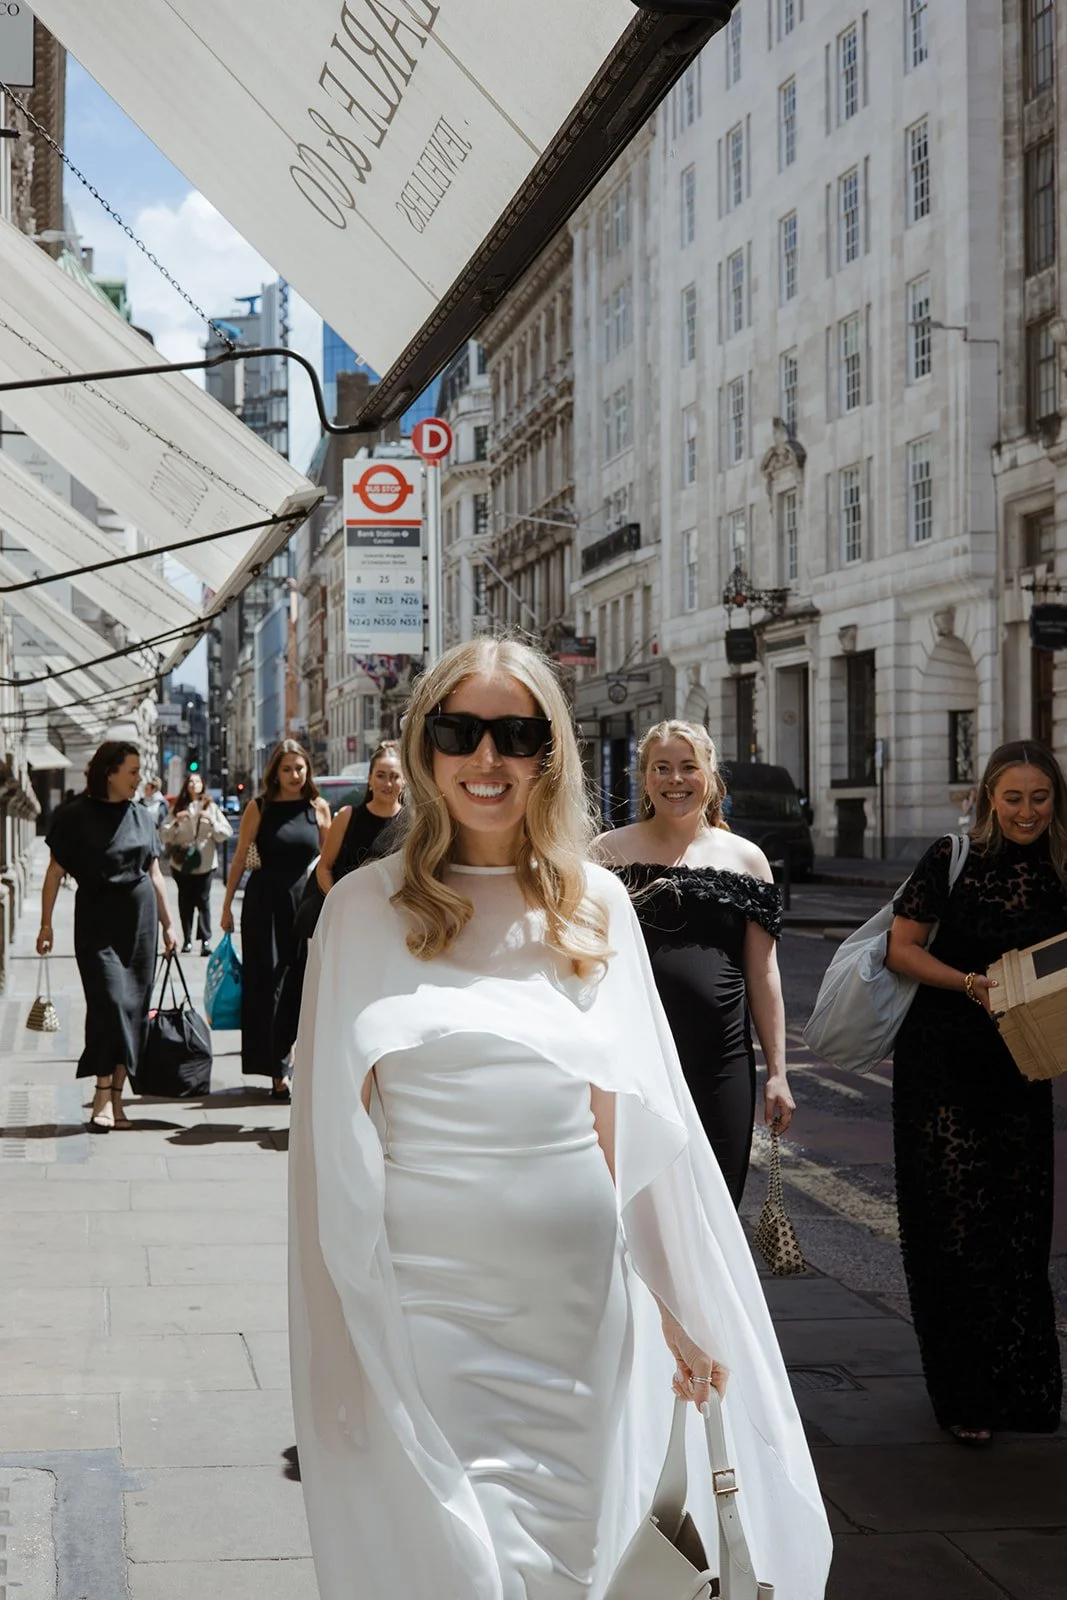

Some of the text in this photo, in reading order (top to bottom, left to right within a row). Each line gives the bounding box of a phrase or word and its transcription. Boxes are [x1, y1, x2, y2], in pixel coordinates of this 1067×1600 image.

[422, 424, 448, 453] D
[365, 485, 402, 493] BUS STOP
[356, 575, 415, 584] 8 25 26
[375, 596, 394, 604] N25
[400, 597, 419, 605] N26
[348, 618, 421, 627] N242 N550 N551
